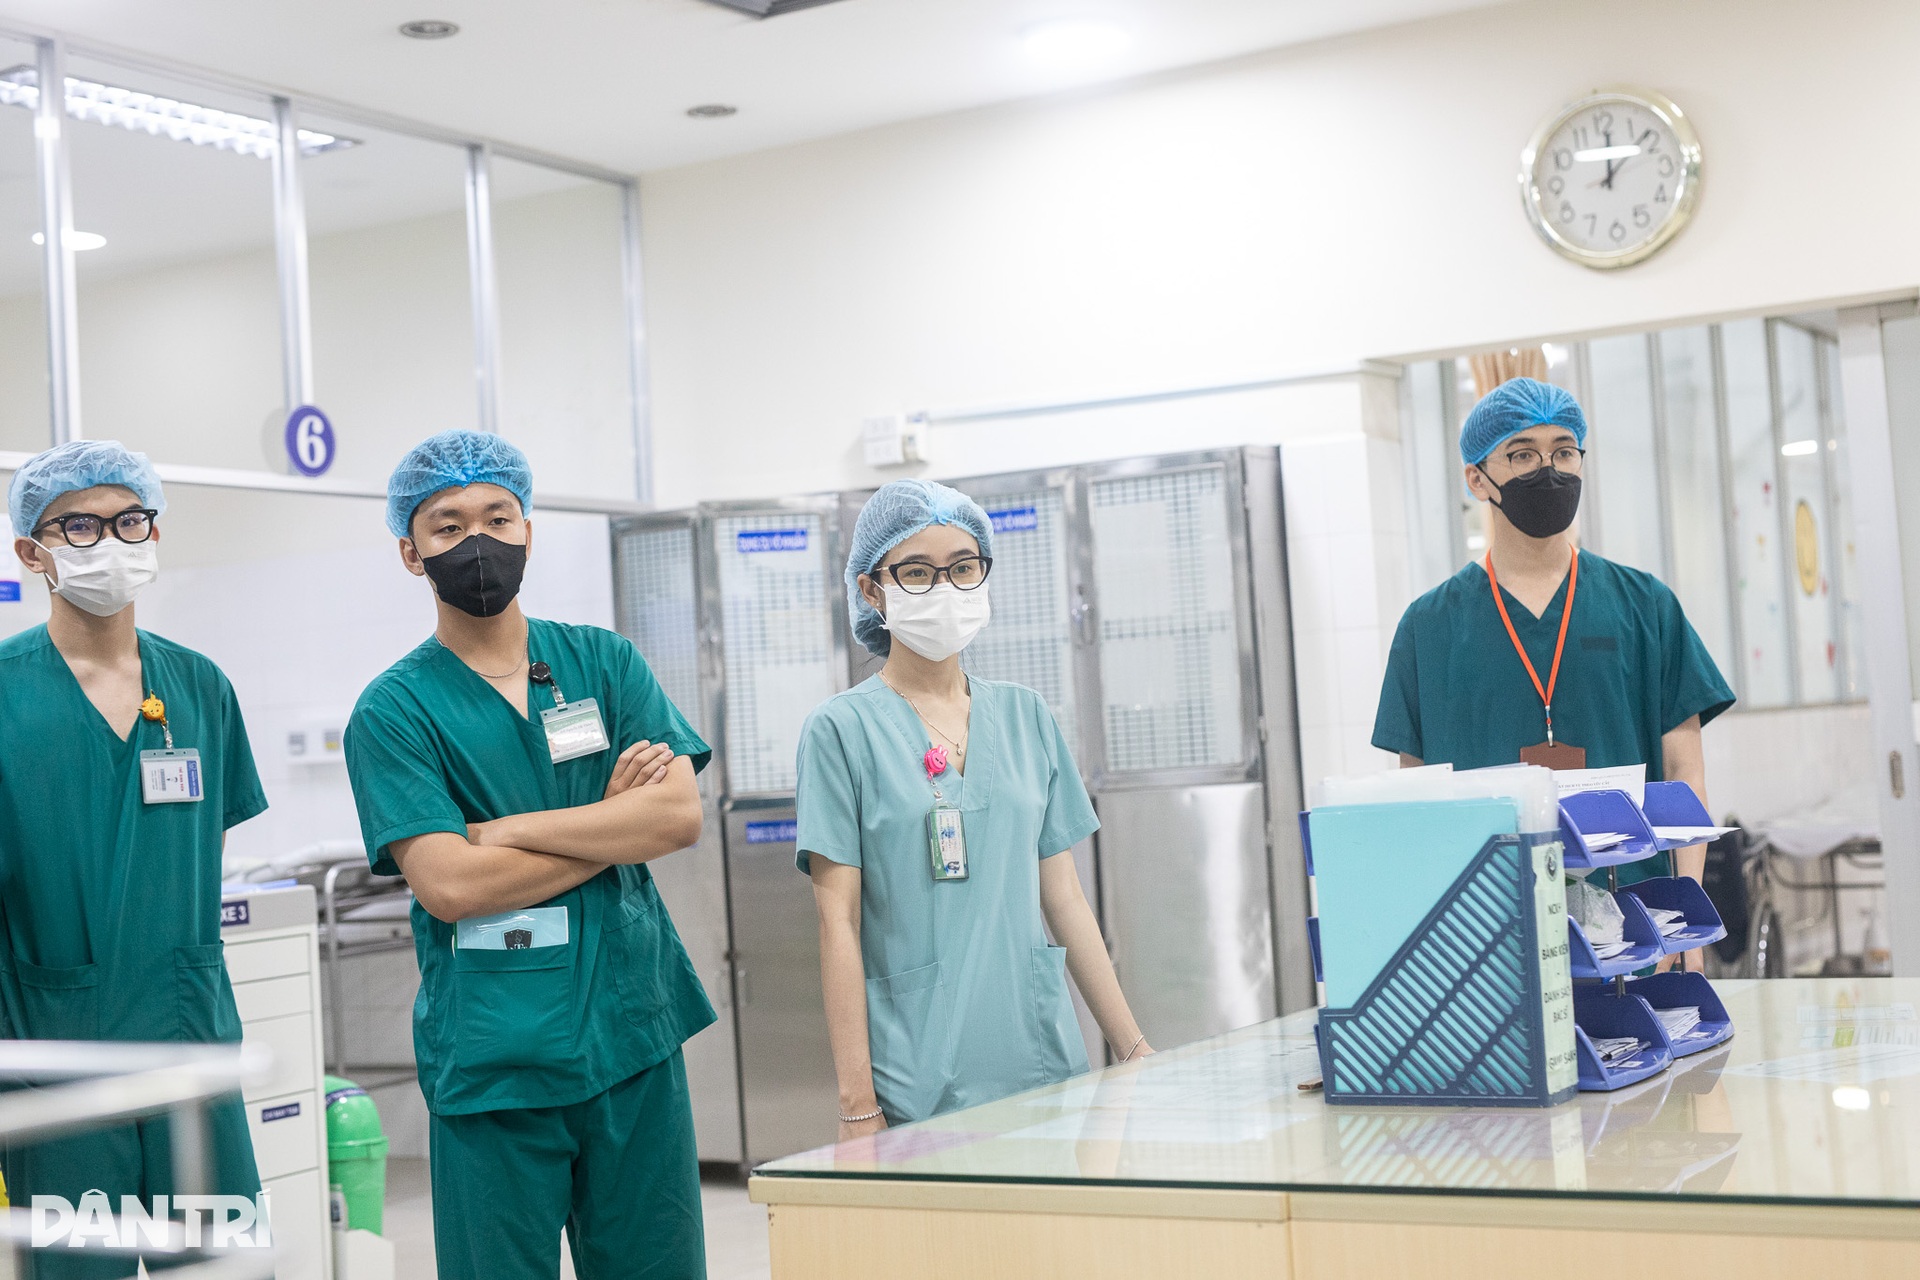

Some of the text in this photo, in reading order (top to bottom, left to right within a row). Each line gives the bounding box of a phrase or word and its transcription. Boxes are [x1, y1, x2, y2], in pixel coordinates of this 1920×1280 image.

[1593, 109, 1614, 137] 12
[1627, 118, 1634, 138] 1
[1573, 126, 1589, 149] 11
[1553, 148, 1574, 171] 10
[1658, 154, 1674, 179] 3
[1547, 175, 1565, 198] 9
[1654, 184, 1668, 204] 4
[1559, 201, 1576, 224] 8
[1632, 204, 1651, 228] 5
[1582, 213, 1598, 237] 7
[1608, 219, 1626, 242] 6
[296, 414, 326, 469] 6
[238, 905, 247, 921] 3
